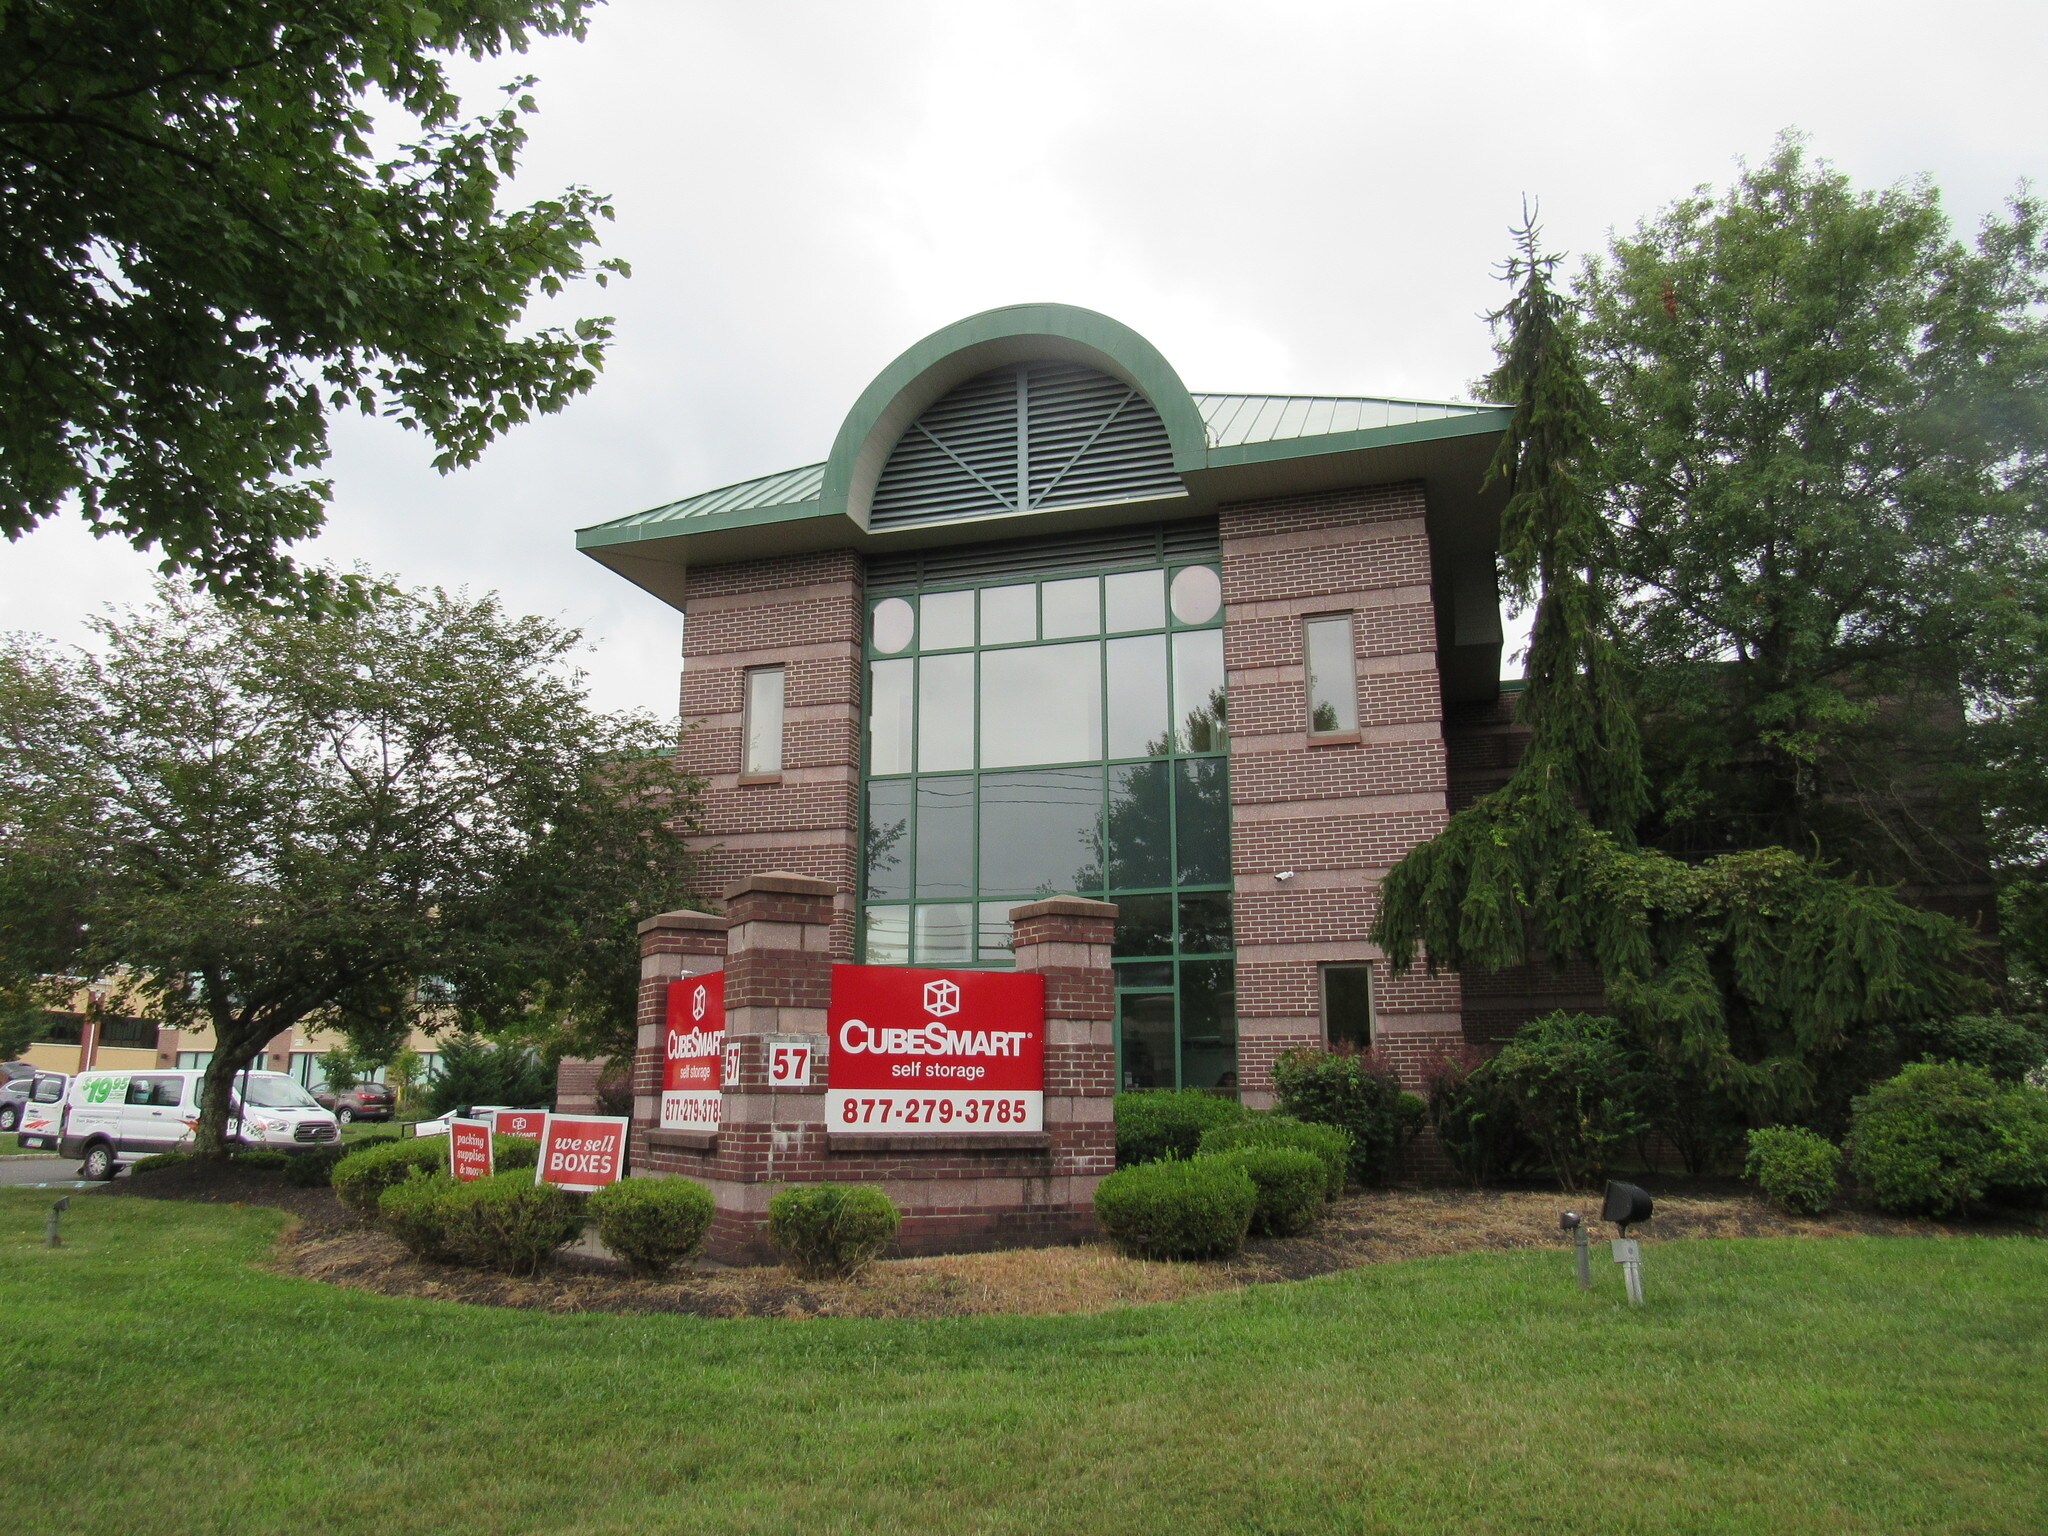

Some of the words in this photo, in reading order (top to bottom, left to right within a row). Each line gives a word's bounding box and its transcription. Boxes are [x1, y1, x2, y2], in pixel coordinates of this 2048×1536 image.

[680, 1064, 690, 1079] self
[690, 1064, 711, 1081] storage
[726, 1048, 740, 1080] 57
[773, 1048, 808, 1080] 57
[891, 1062, 922, 1077] self
[925, 1063, 985, 1080] storage
[842, 1098, 1026, 1124] 877-279-3785
[457, 1132, 484, 1149] packing
[554, 1137, 582, 1151] we
[583, 1135, 615, 1152] sell
[457, 1148, 486, 1162] supplies
[550, 1152, 612, 1174] BOXES
[459, 1162, 465, 1174] &
